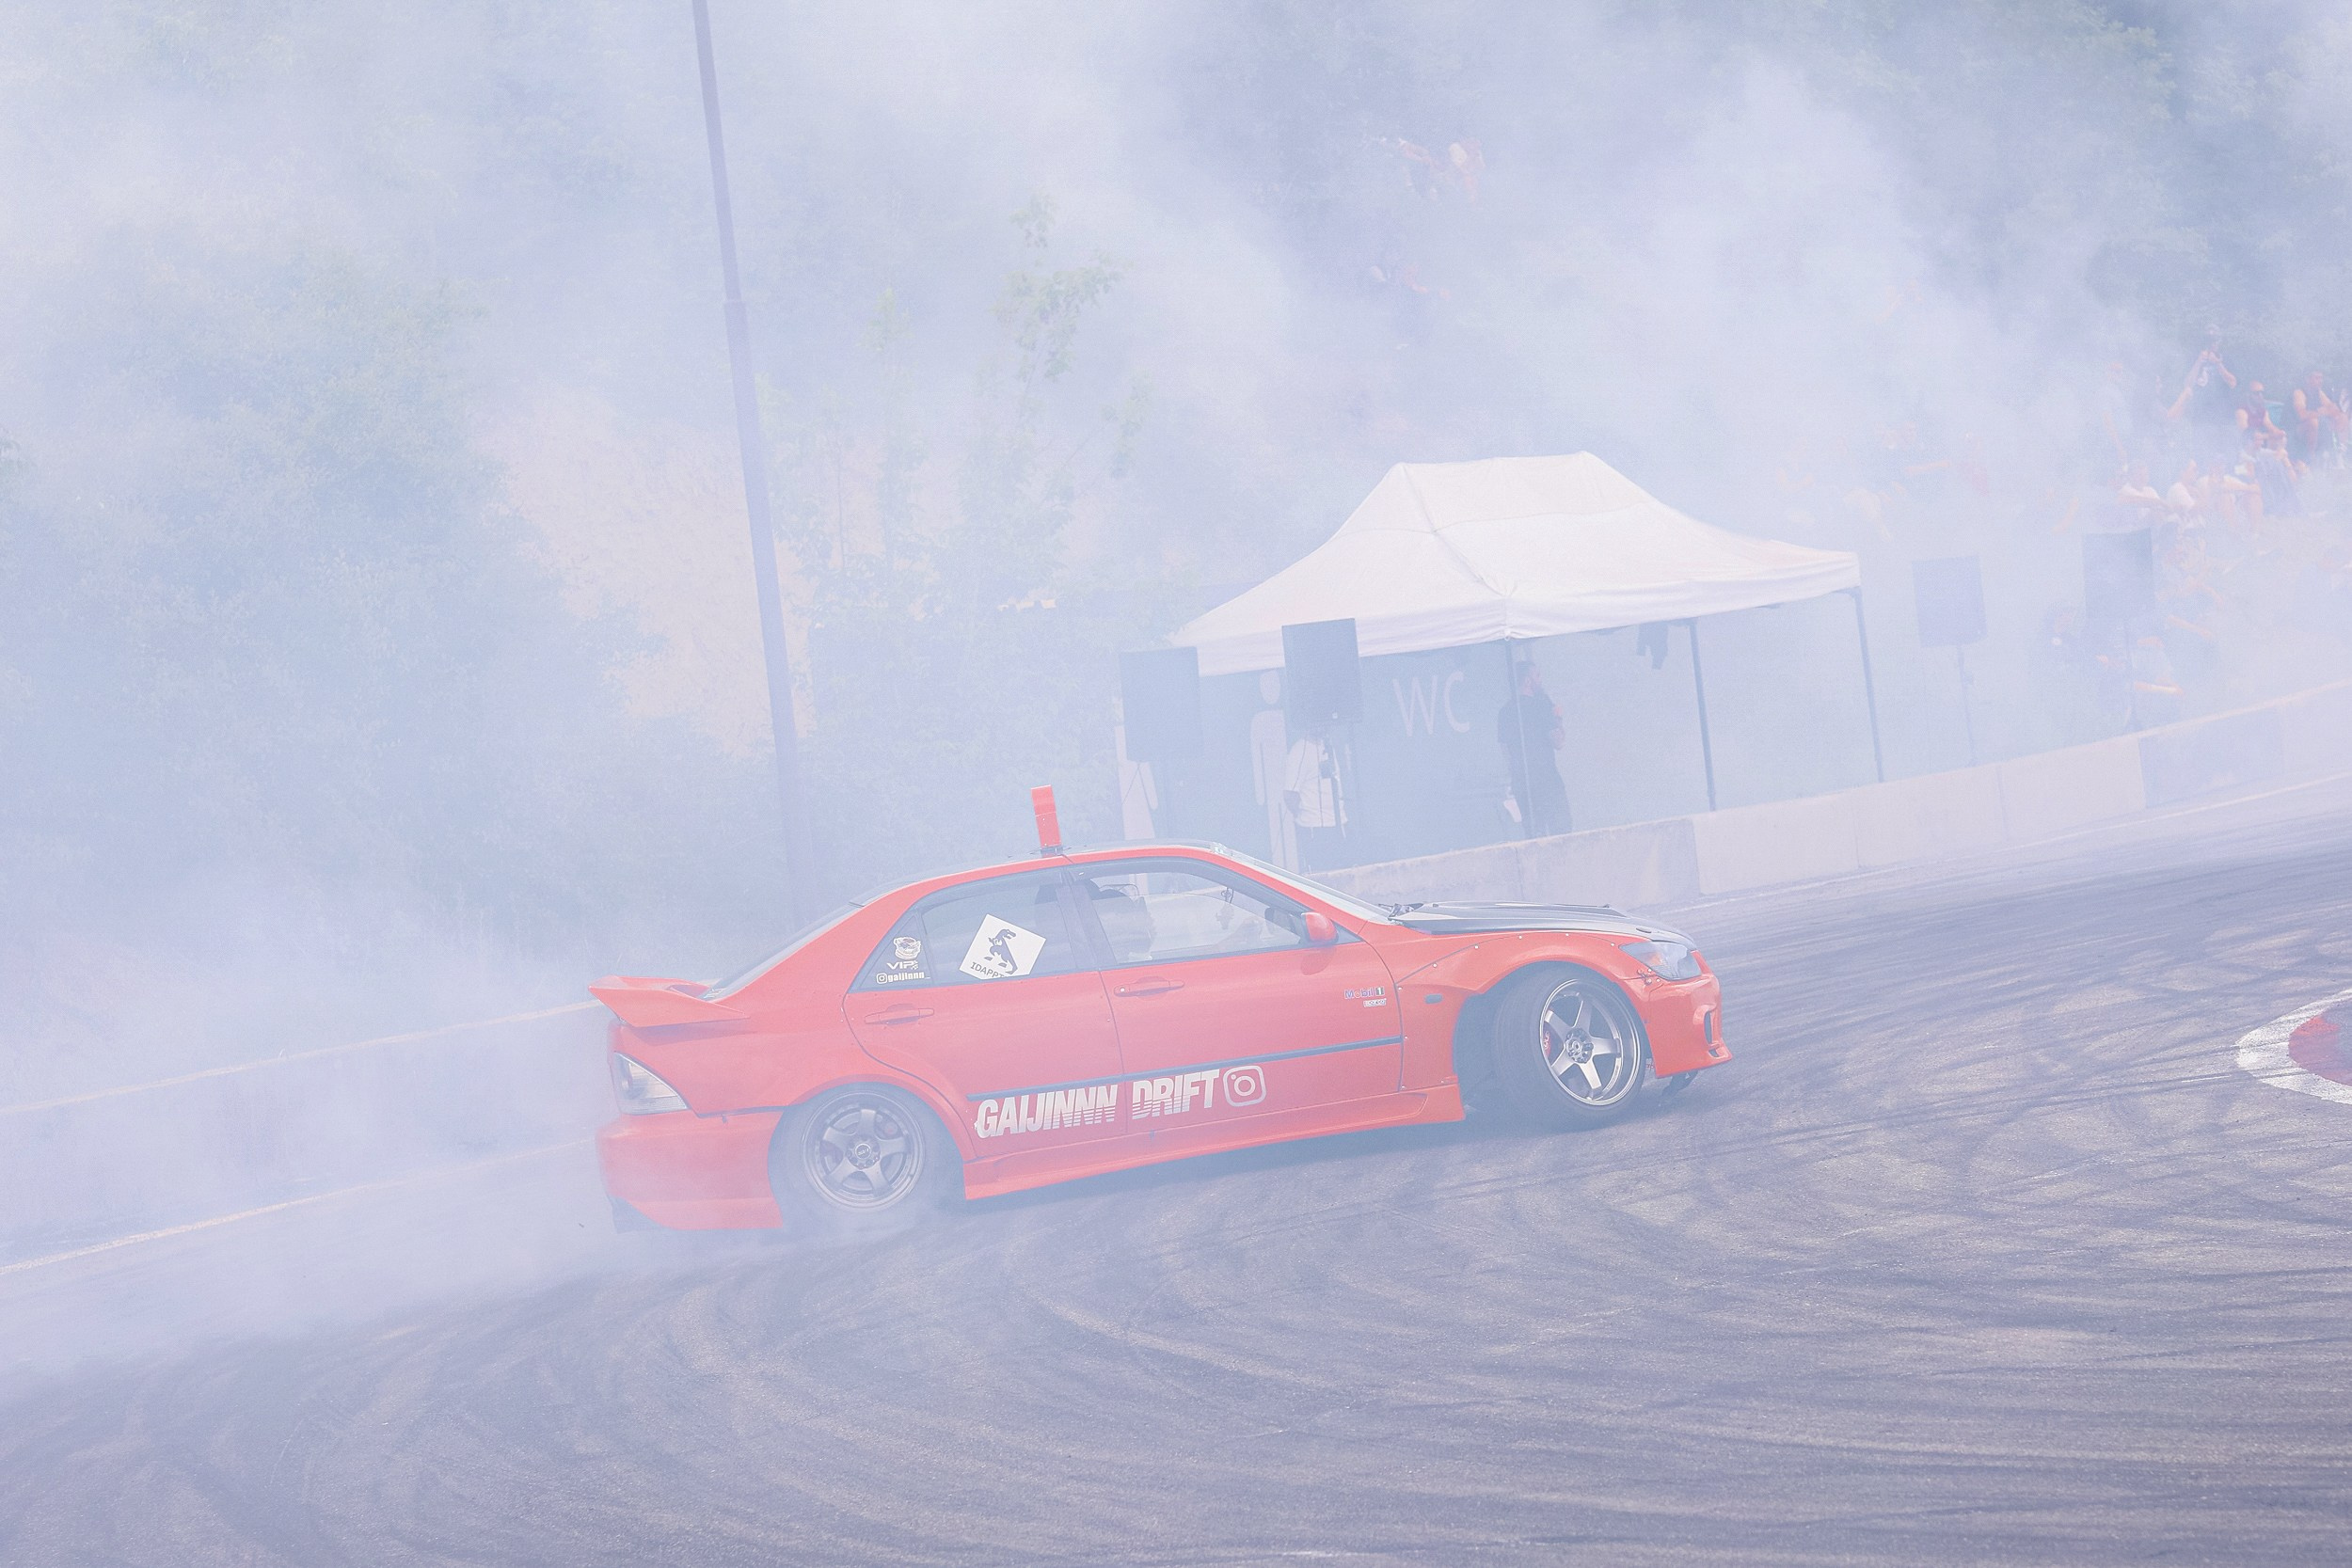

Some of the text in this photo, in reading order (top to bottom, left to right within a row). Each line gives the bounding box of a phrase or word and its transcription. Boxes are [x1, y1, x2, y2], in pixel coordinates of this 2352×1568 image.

[1392, 670, 1470, 737] WC
[1344, 987, 1384, 999] Mobil 1
[974, 1069, 1220, 1138] GAIJINNN DRIFT
